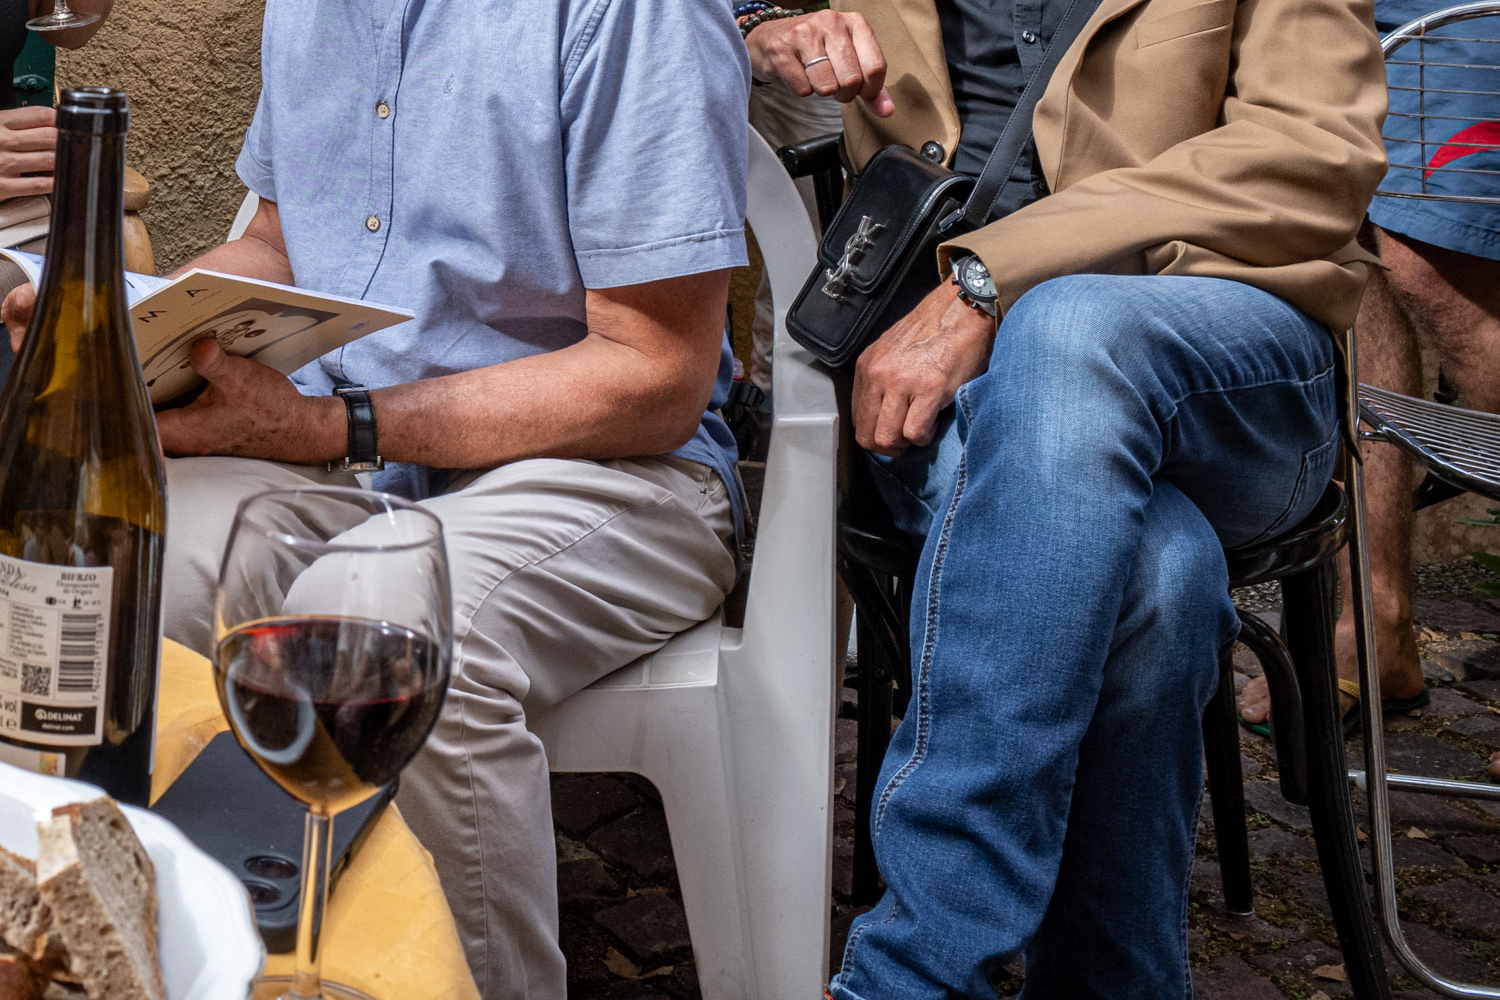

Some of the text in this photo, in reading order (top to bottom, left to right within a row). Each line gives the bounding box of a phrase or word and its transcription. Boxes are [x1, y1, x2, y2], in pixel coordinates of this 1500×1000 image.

[60, 572, 97, 581] BIERZO
[4, 700, 17, 713] vol
[47, 711, 83, 722] DELINAT
